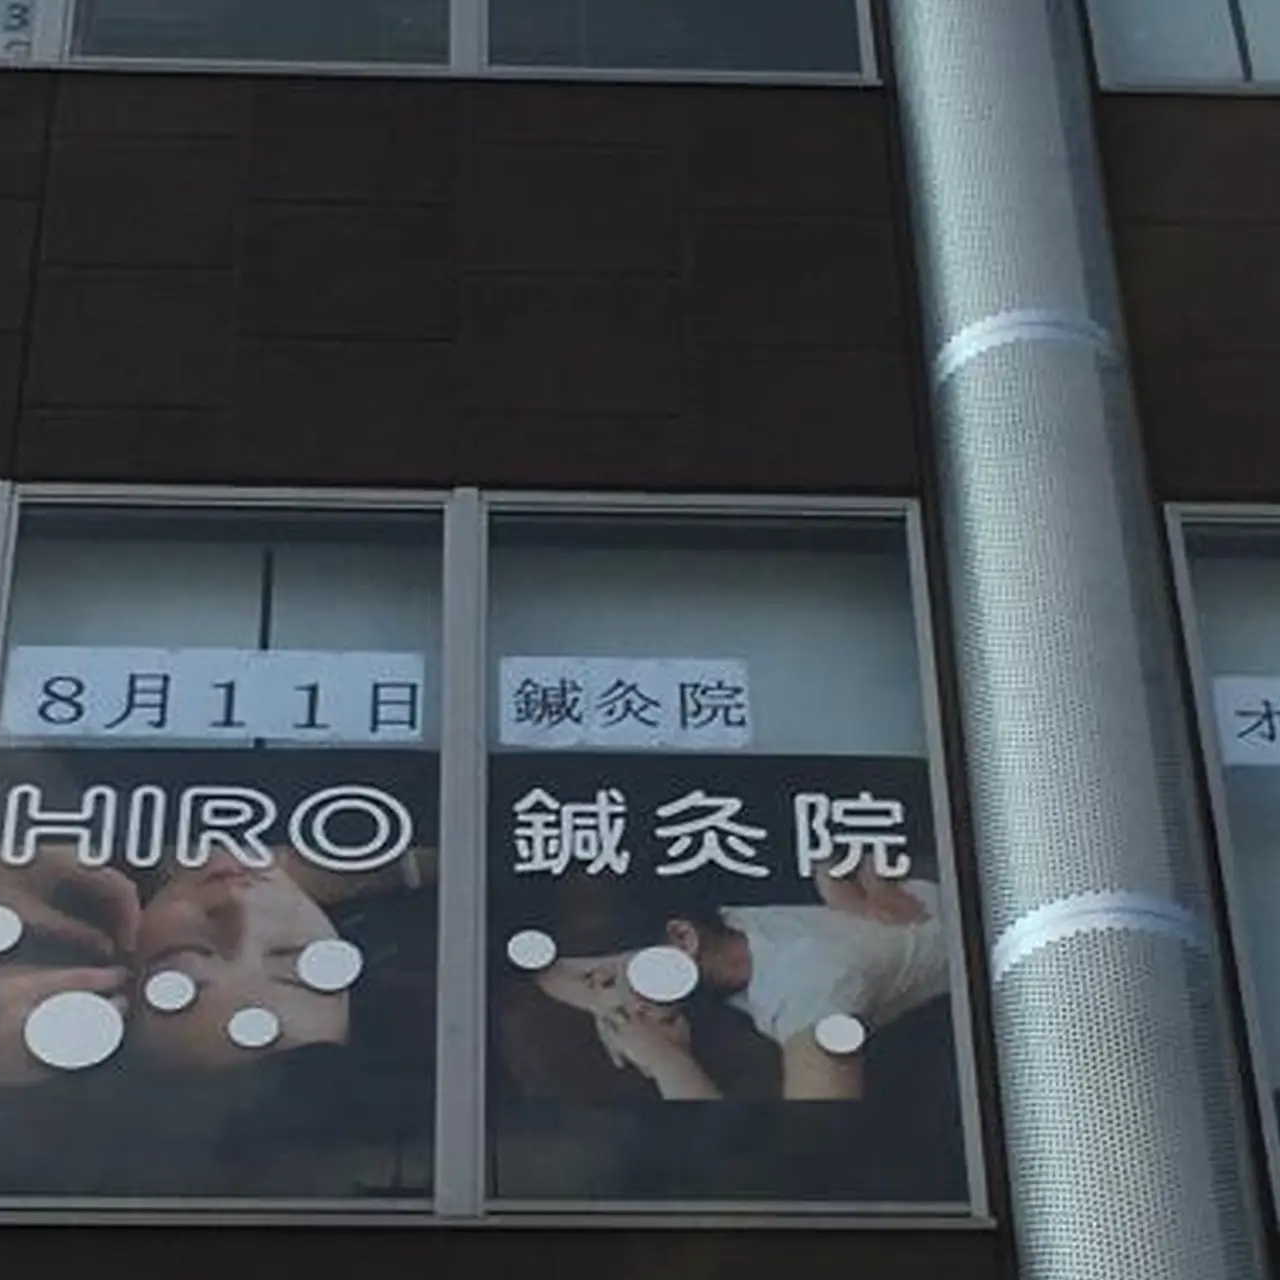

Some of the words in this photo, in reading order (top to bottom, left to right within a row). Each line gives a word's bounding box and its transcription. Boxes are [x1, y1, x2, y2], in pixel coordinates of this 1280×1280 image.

[512, 677, 749, 730] 鍼灸院
[1, 785, 414, 871] HIRO
[511, 787, 912, 879] 鍼灸院
